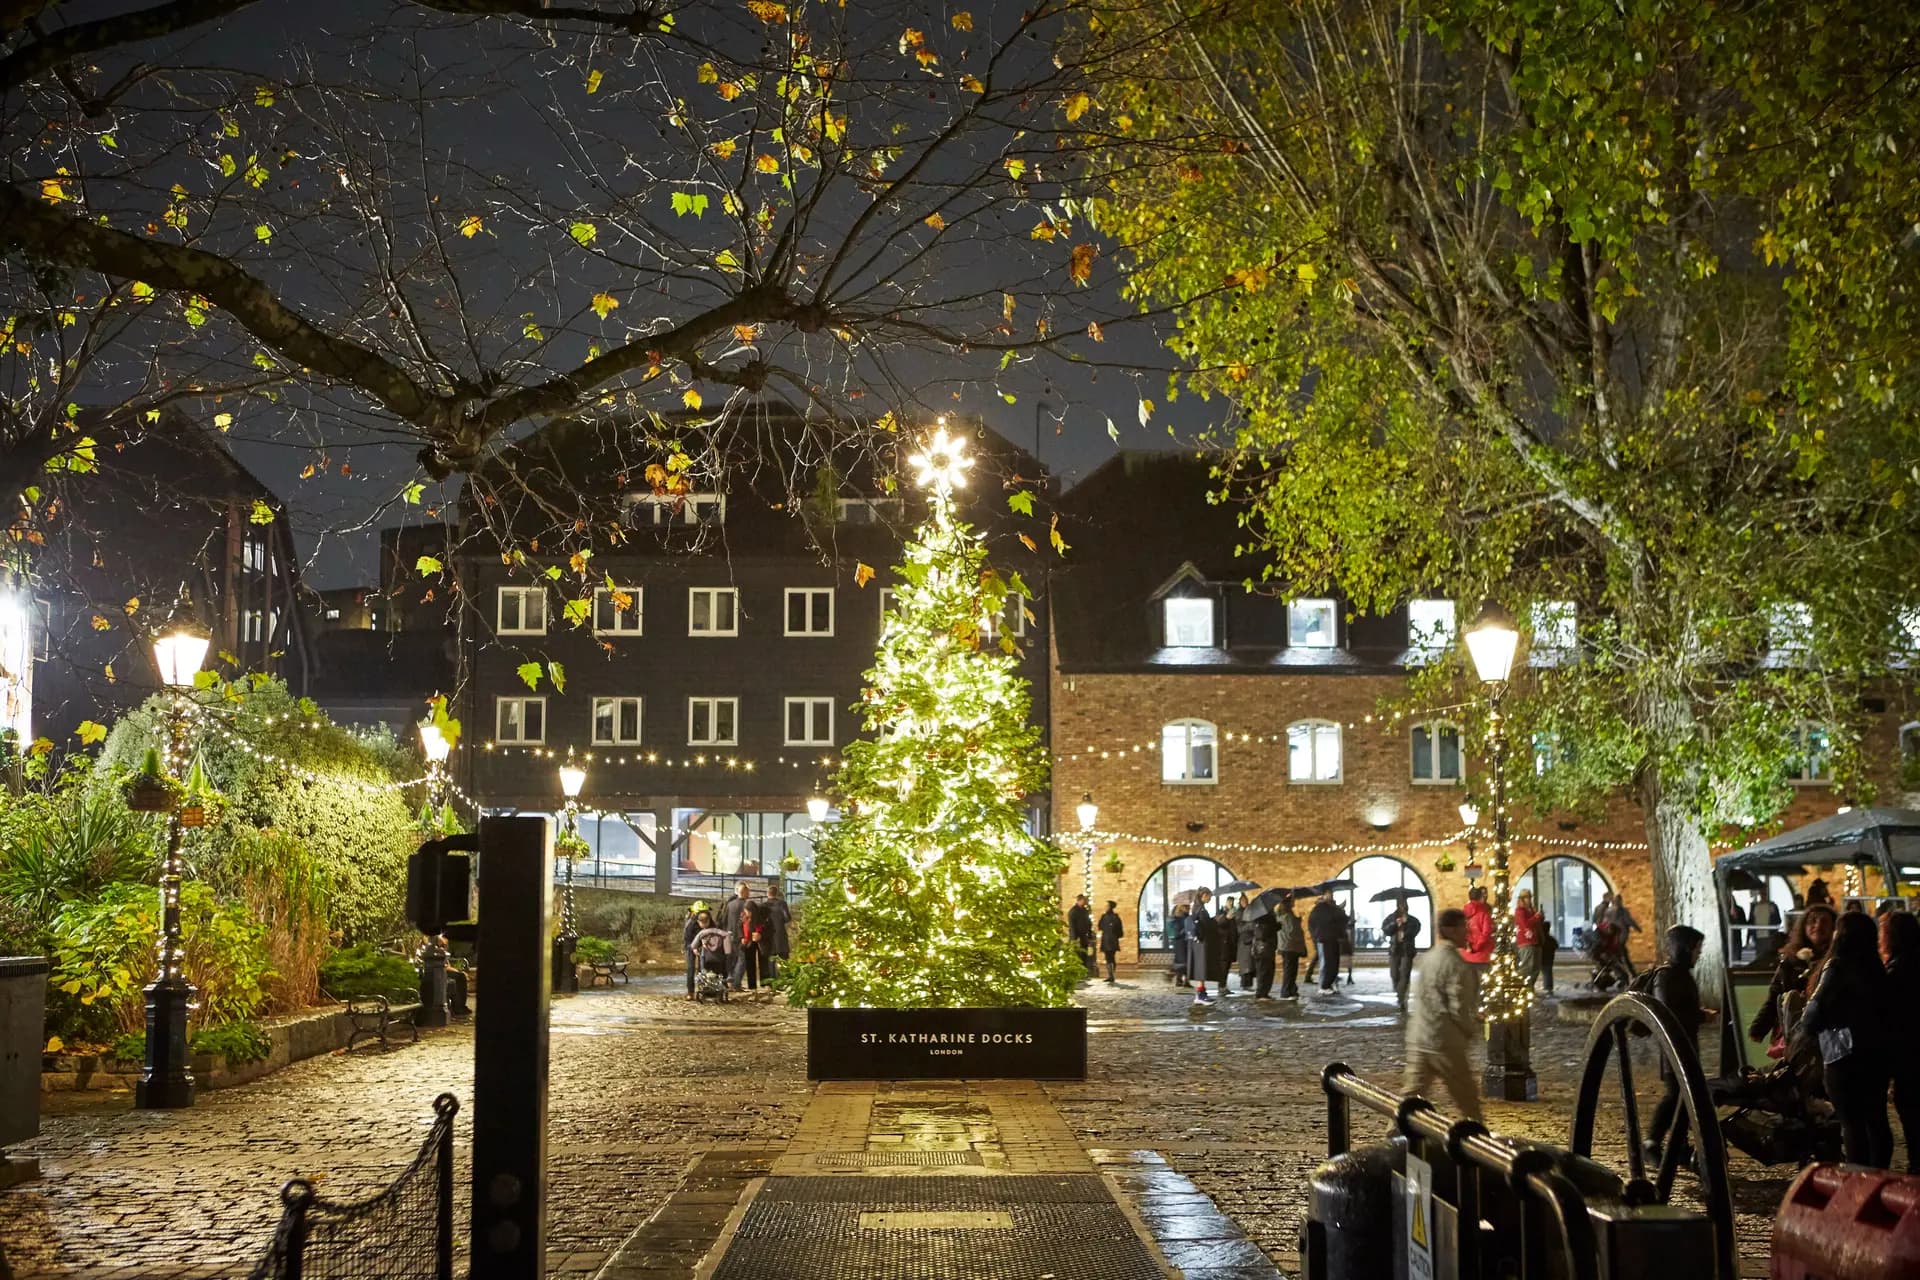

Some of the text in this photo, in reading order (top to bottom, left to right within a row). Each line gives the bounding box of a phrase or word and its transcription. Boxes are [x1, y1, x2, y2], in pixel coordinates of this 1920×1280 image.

[860, 1033, 1033, 1044] ST. KATHARINE DOCKS
